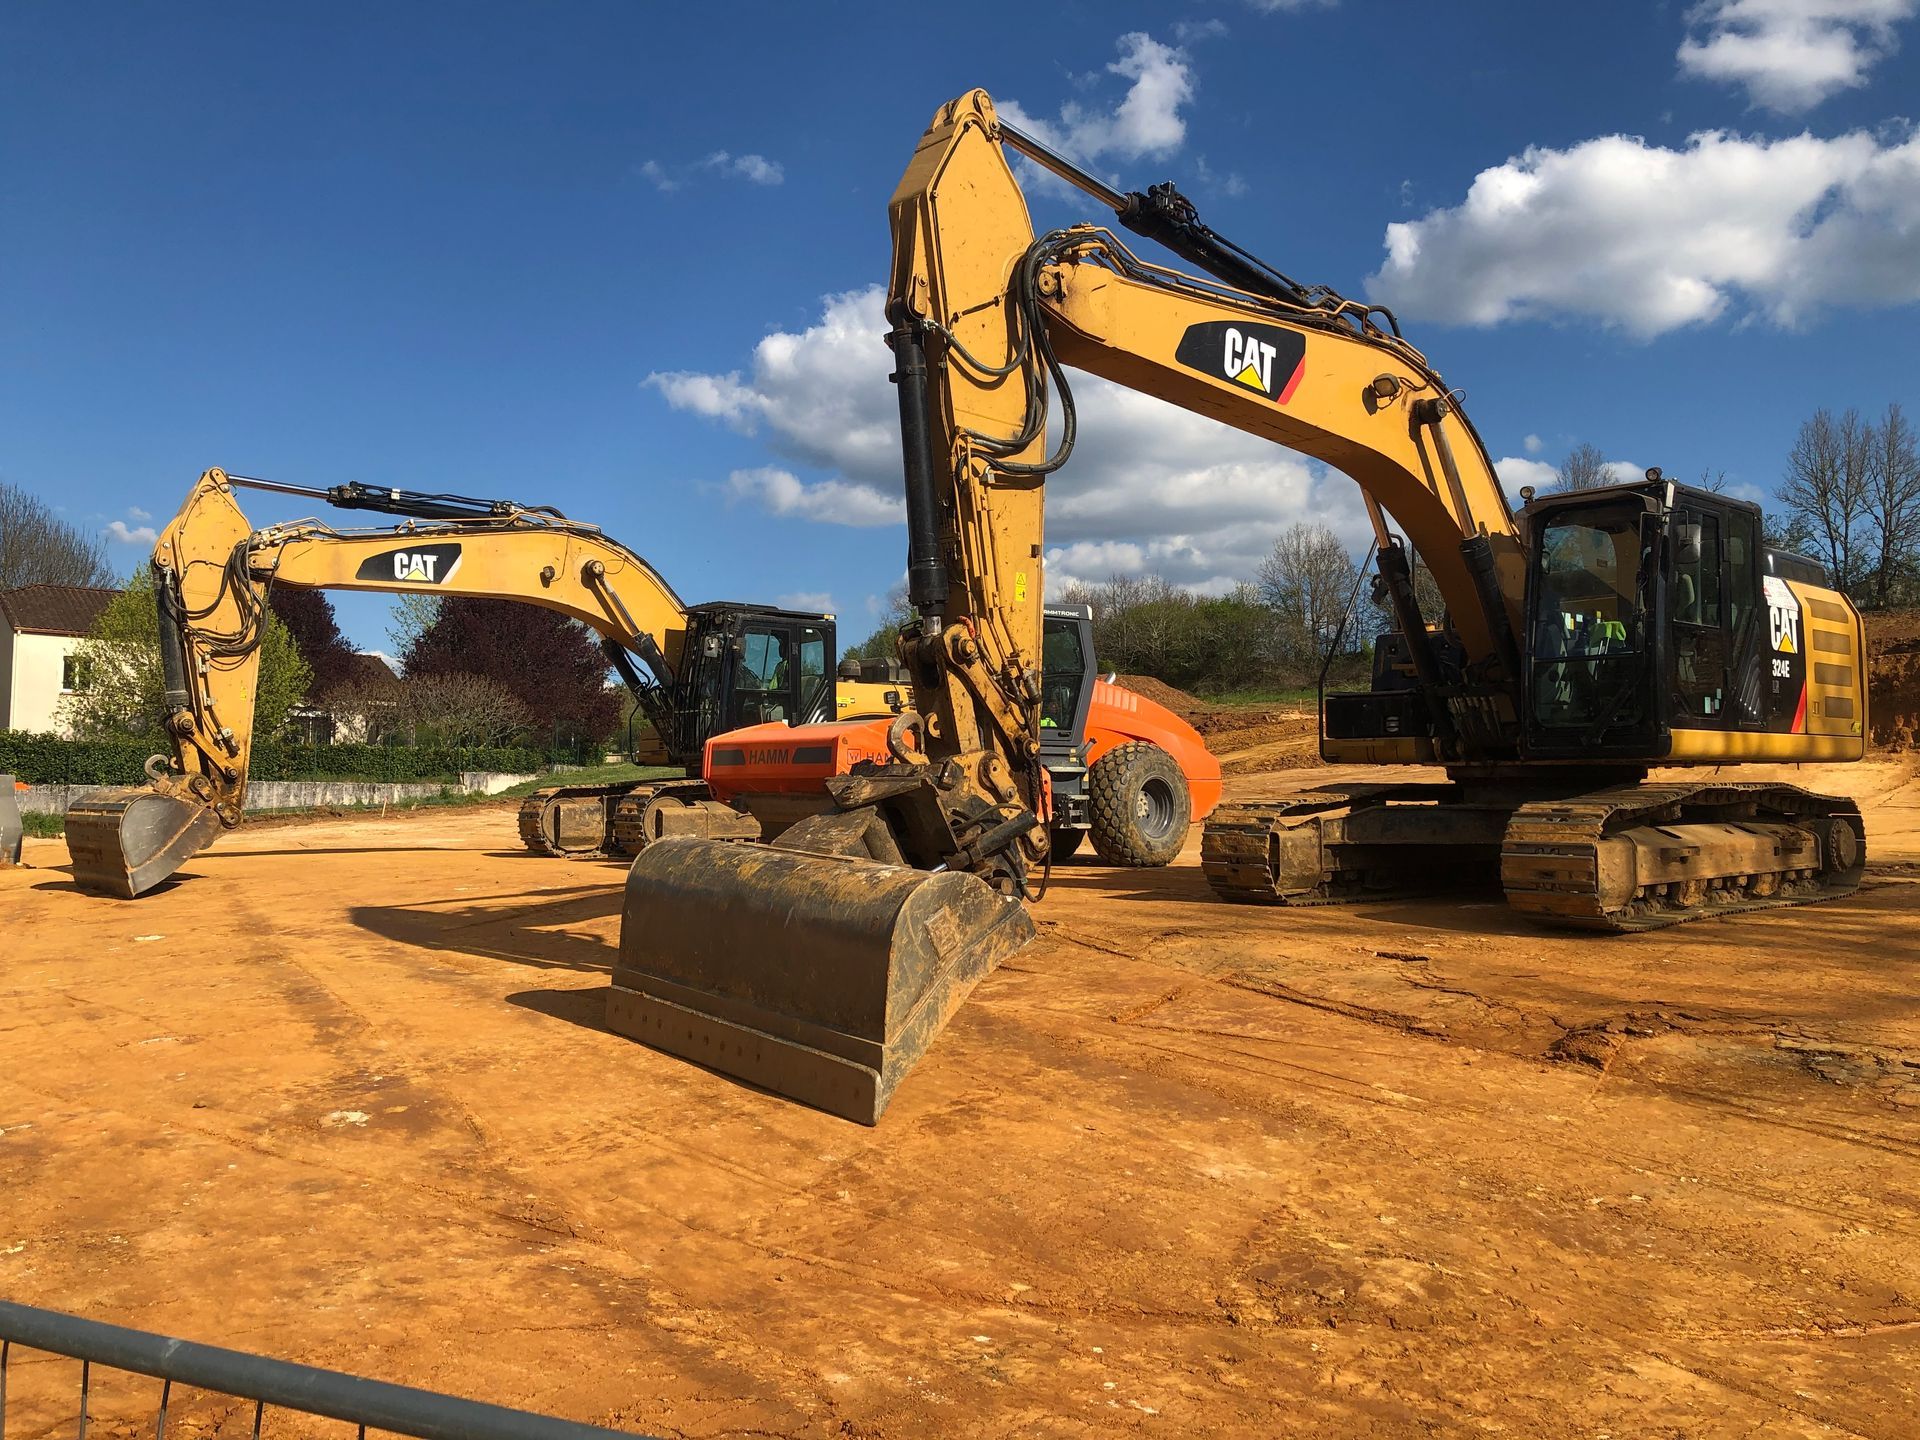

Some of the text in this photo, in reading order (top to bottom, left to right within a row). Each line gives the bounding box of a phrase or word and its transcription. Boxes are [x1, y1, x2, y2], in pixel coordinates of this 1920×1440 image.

[1223, 327, 1277, 394] CAT
[394, 552, 437, 581] CAT
[1043, 609, 1080, 617] AMMTRONIC
[1769, 606, 1799, 654] CAT
[1772, 658, 1790, 678] 324E
[749, 749, 789, 765] HAMM
